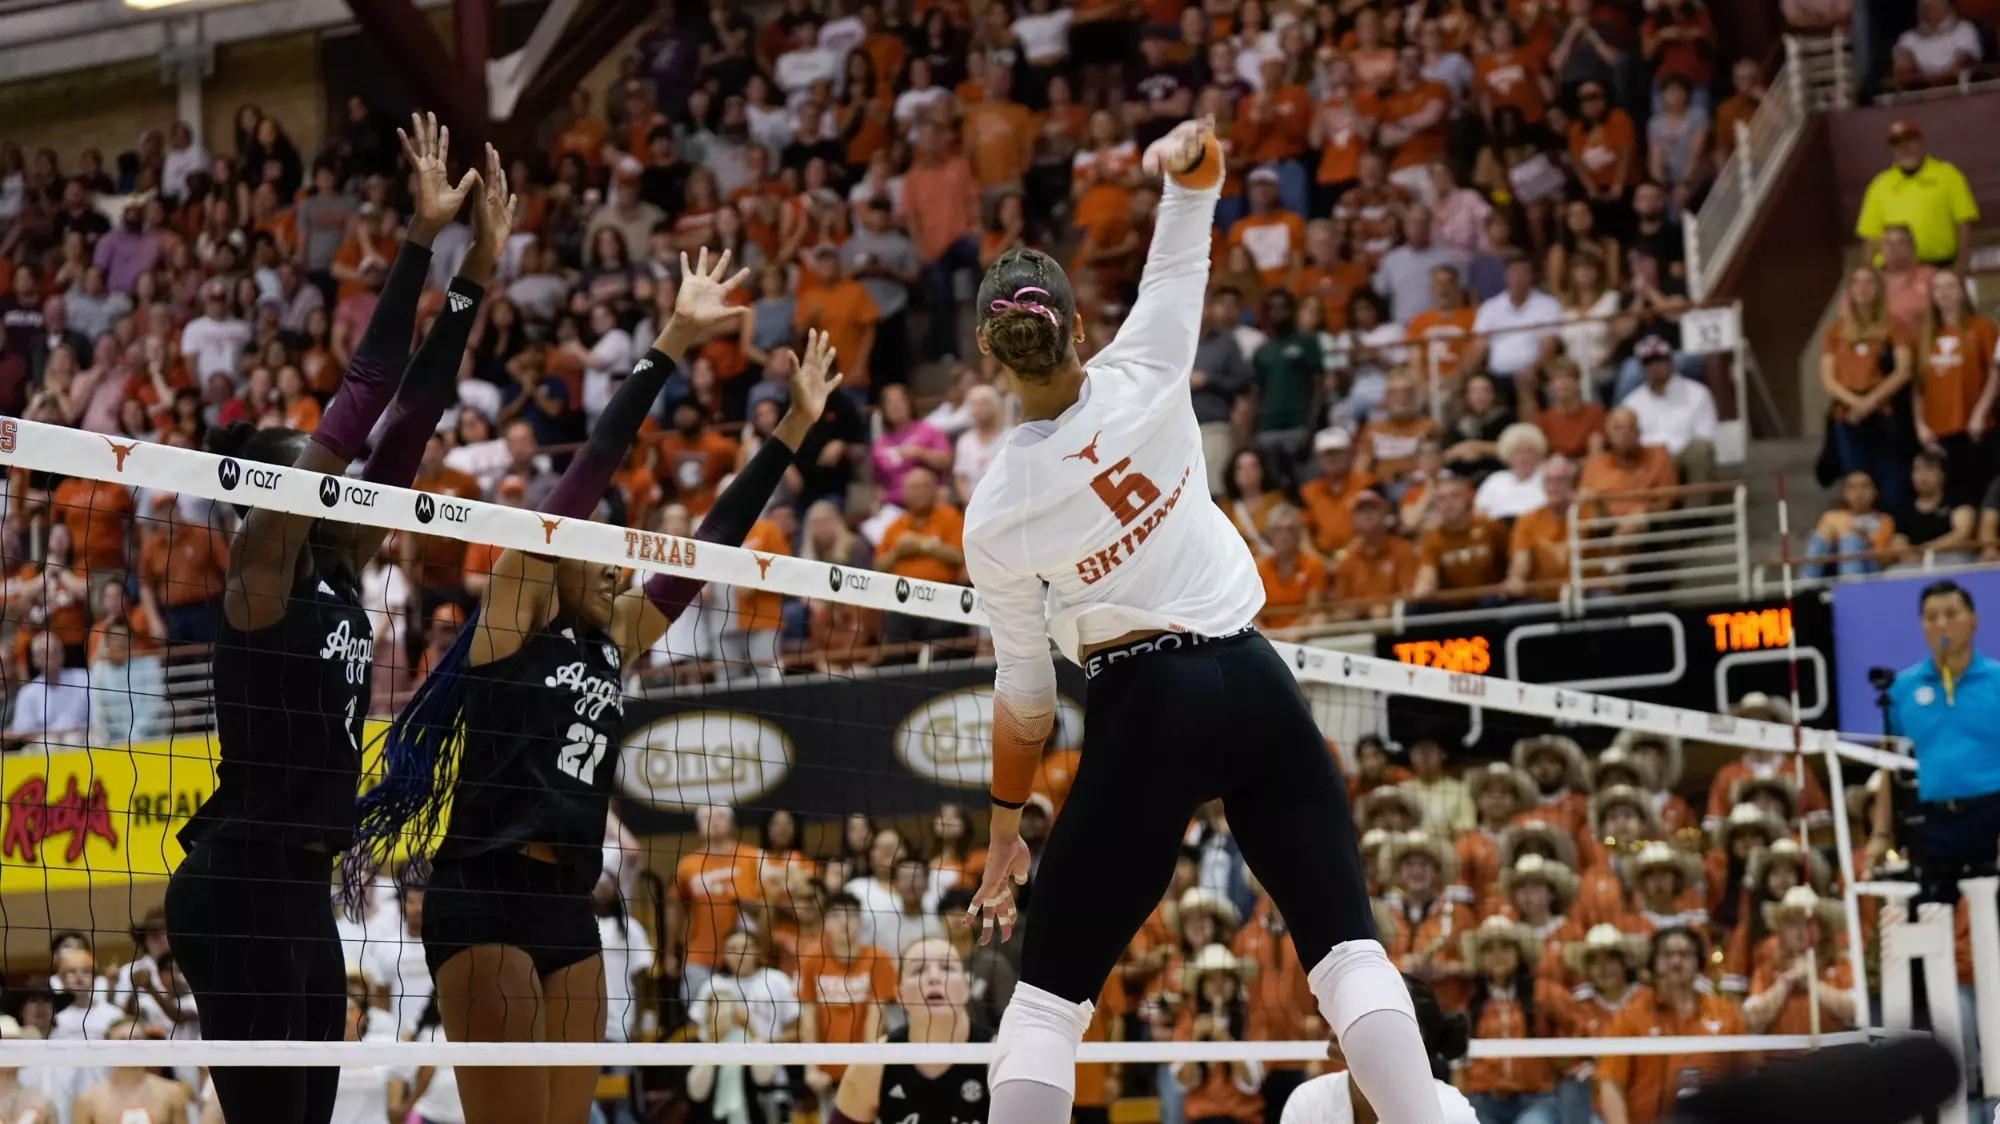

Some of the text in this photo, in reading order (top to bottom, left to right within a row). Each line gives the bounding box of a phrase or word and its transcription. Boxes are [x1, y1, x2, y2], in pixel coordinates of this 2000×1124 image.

[245, 467, 282, 490] razr
[1089, 456, 1161, 528] 6
[344, 486, 379, 508] razr
[439, 503, 472, 523] razr
[624, 530, 698, 569] TEXAS
[845, 574, 871, 591] razr
[911, 585, 937, 602] razr
[1706, 607, 1792, 652] TAMU
[1392, 636, 1490, 674] TEXAS
[557, 722, 607, 785] 21
